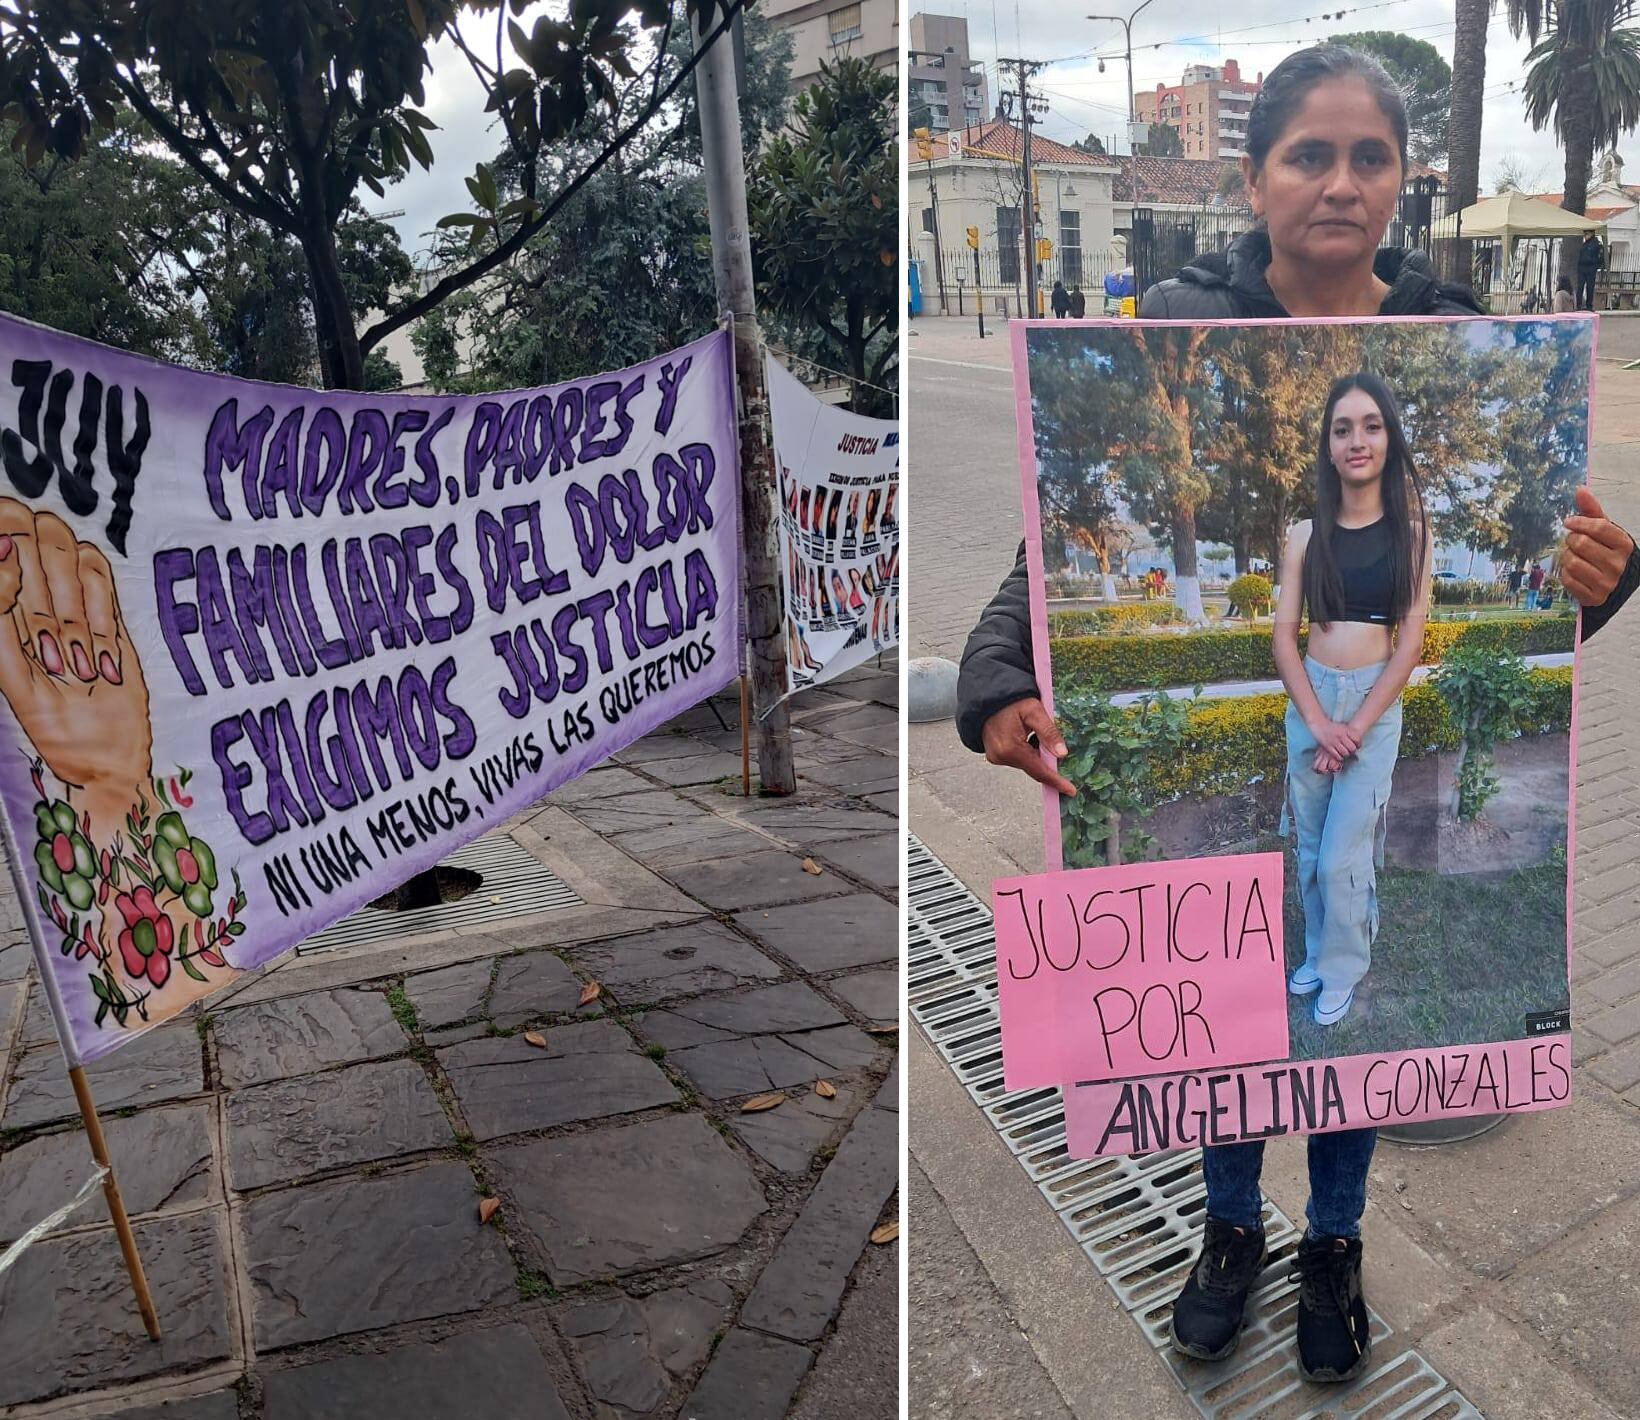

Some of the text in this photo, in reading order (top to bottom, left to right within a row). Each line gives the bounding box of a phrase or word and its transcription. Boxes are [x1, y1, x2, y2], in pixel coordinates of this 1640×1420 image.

[204, 357, 692, 521] MADRES, PADRES Y
[837, 433, 879, 455] JUSTICIA
[153, 443, 716, 696] FAMILIARES DEL DOLOR
[210, 549, 717, 846] EXIGIMOS JUSTICIA
[262, 631, 717, 917] NI UNA MENOS, VIVAS LAS QUEREMOS
[997, 877, 1275, 980] JUSTICIA
[1093, 980, 1216, 1069] POR
[1535, 1020, 1561, 1031] BLOCK
[1095, 1043, 1570, 1155] ANGELINA GONZALES
